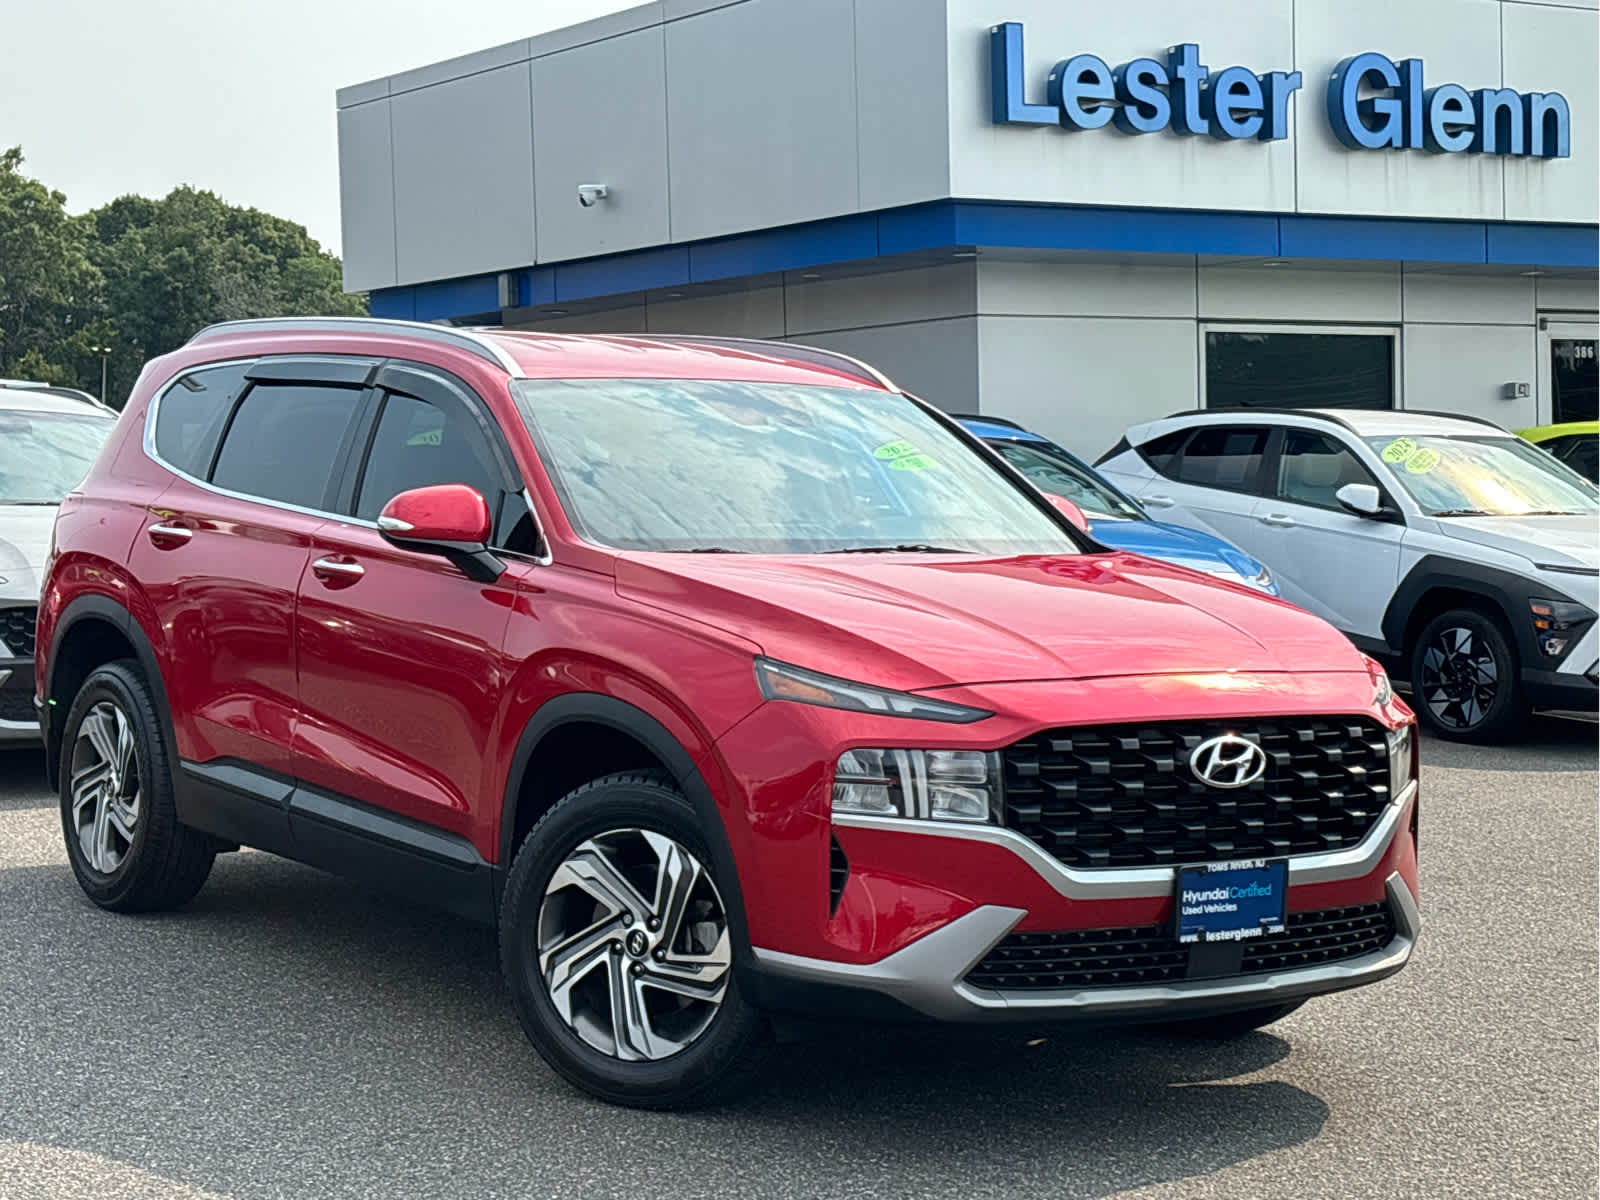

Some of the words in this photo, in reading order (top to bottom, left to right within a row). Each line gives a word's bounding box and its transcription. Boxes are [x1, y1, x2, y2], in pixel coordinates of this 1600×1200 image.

[991, 22, 1302, 141] Lester
[1328, 52, 1570, 159] Glenn
[1574, 345, 1594, 359] 386
[1207, 862, 1229, 873] TOMS
[1182, 887, 1230, 904] Hyundai
[1230, 881, 1272, 898] Certified
[1182, 905, 1203, 915] Used
[1204, 903, 1238, 913] Vehicles
[1206, 927, 1263, 942] lesterglenn
